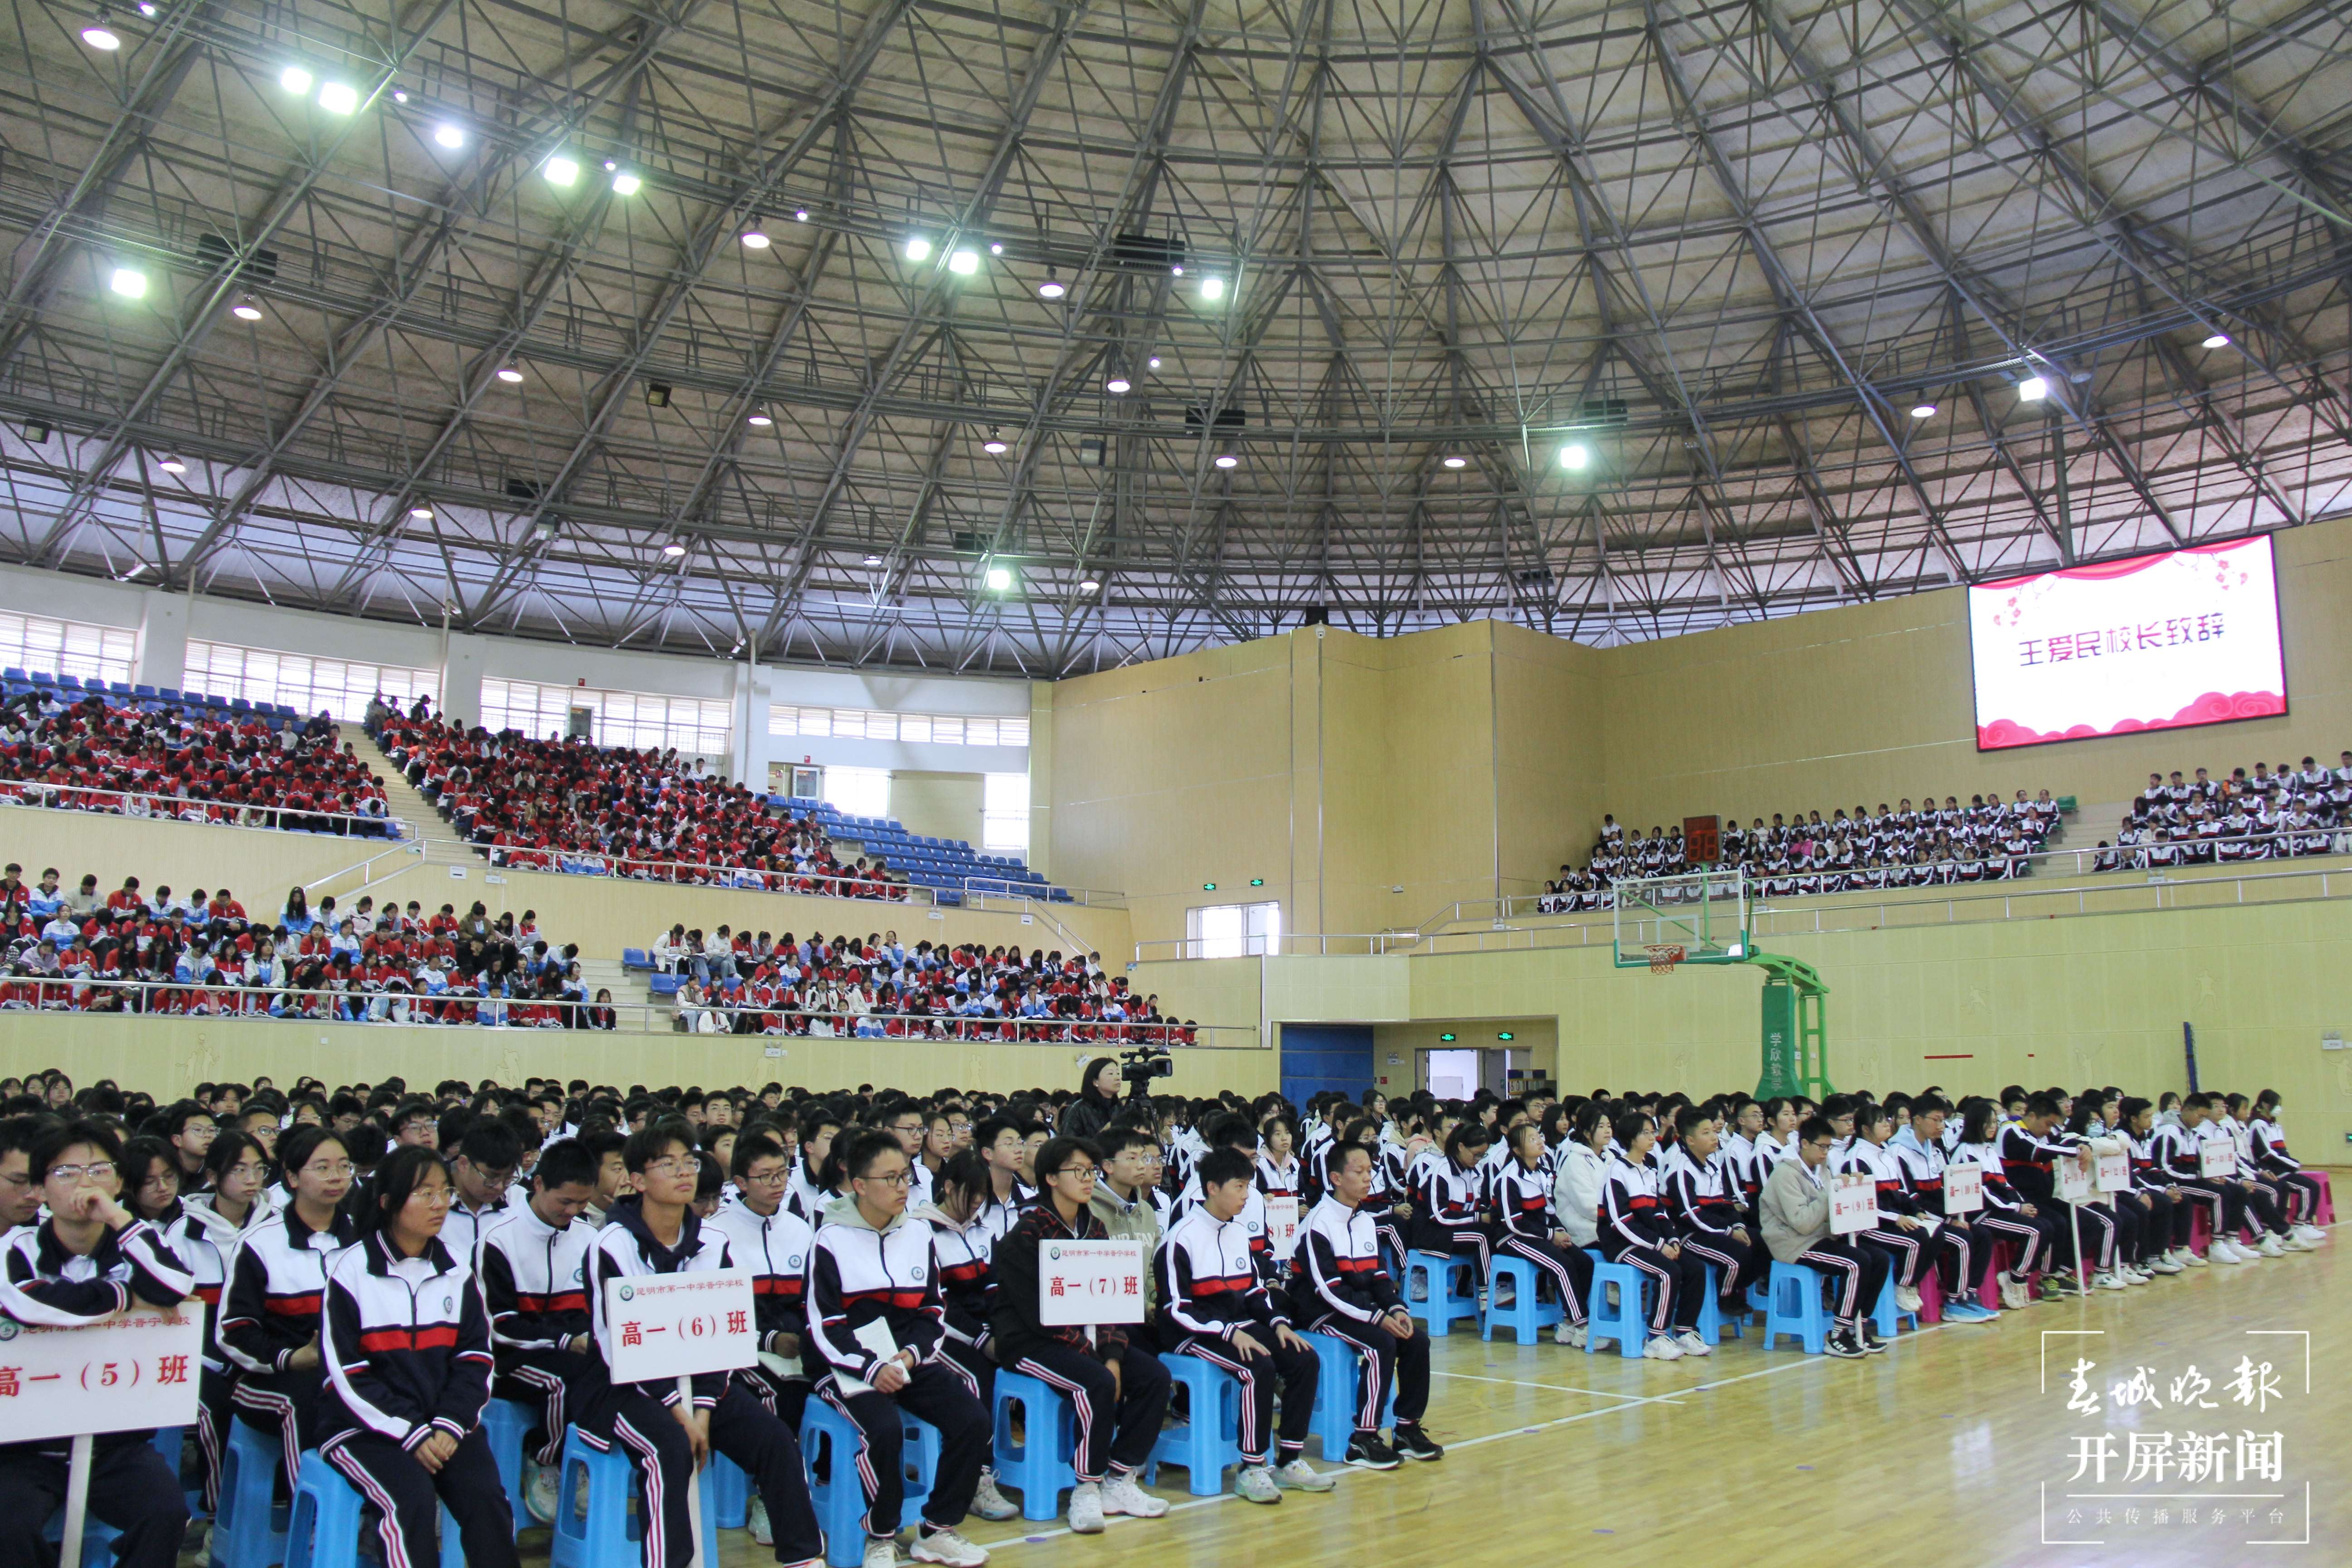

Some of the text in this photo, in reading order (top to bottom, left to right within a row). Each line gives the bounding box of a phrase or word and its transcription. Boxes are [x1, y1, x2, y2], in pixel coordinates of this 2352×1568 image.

[2019, 612, 2225, 666] 王爱民校长致辞
[1835, 1198, 1874, 1215] 高一（9）班
[636, 1279, 745, 1296] 昆明市第一中学晋宁学校
[1050, 1275, 1138, 1297] 高一（7）班
[621, 1310, 748, 1347] 高一（6）班
[0, 1355, 189, 1397] 高一（5）班
